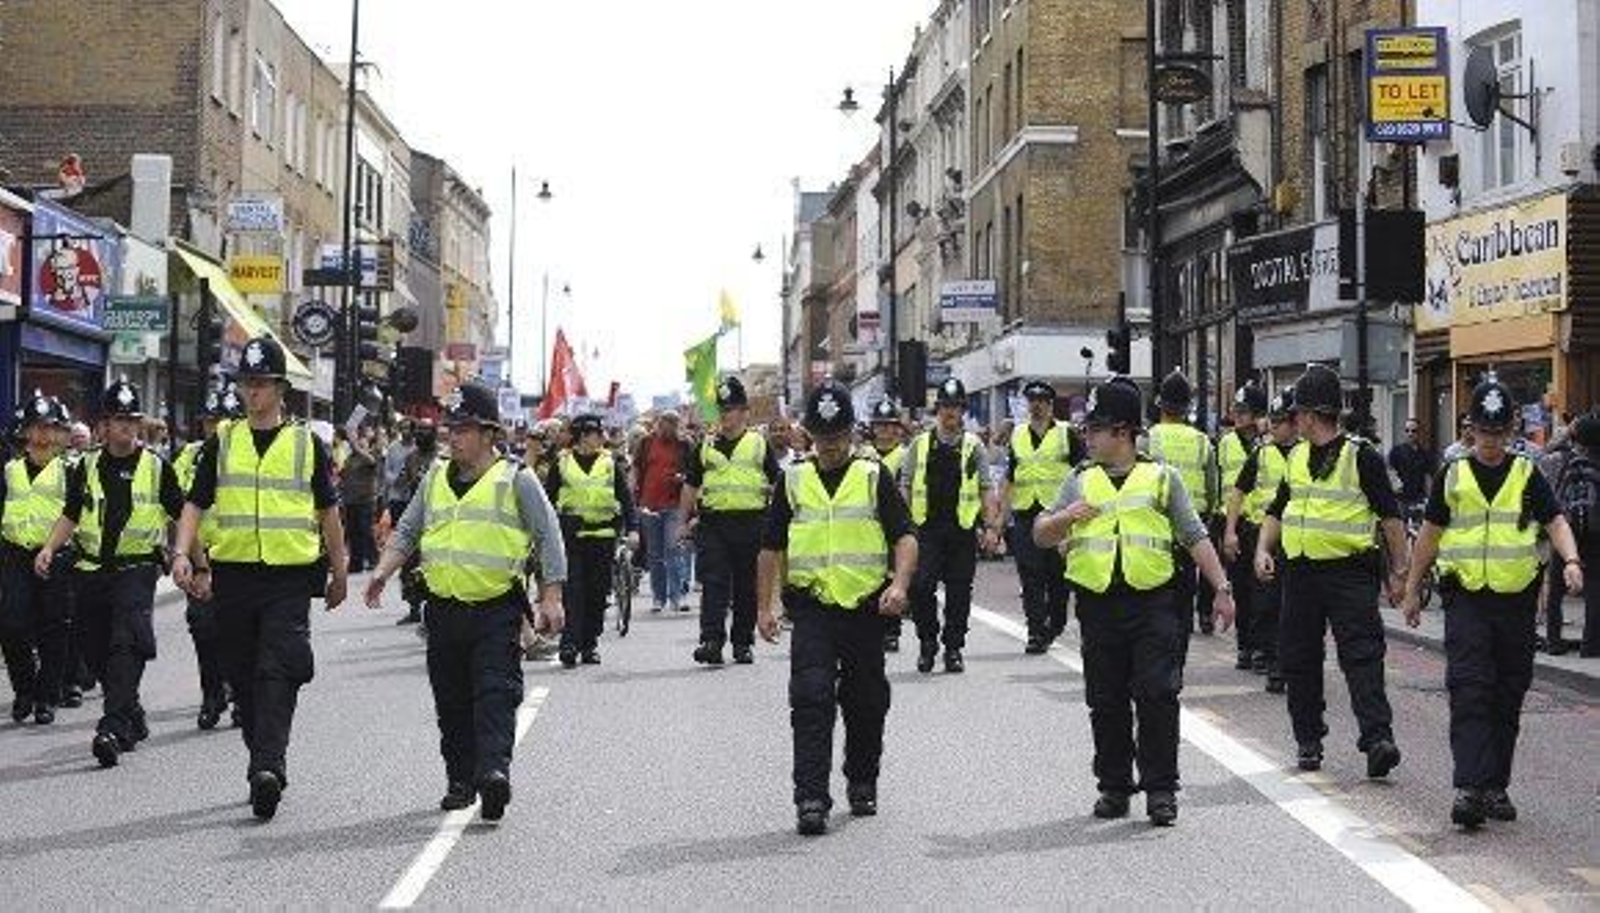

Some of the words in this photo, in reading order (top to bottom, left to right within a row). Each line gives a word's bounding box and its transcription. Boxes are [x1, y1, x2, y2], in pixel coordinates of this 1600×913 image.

[1378, 83, 1401, 99] TO
[1408, 83, 1441, 99] LET
[1457, 219, 1559, 267] Caribbean
[231, 265, 281, 280] HARVEST
